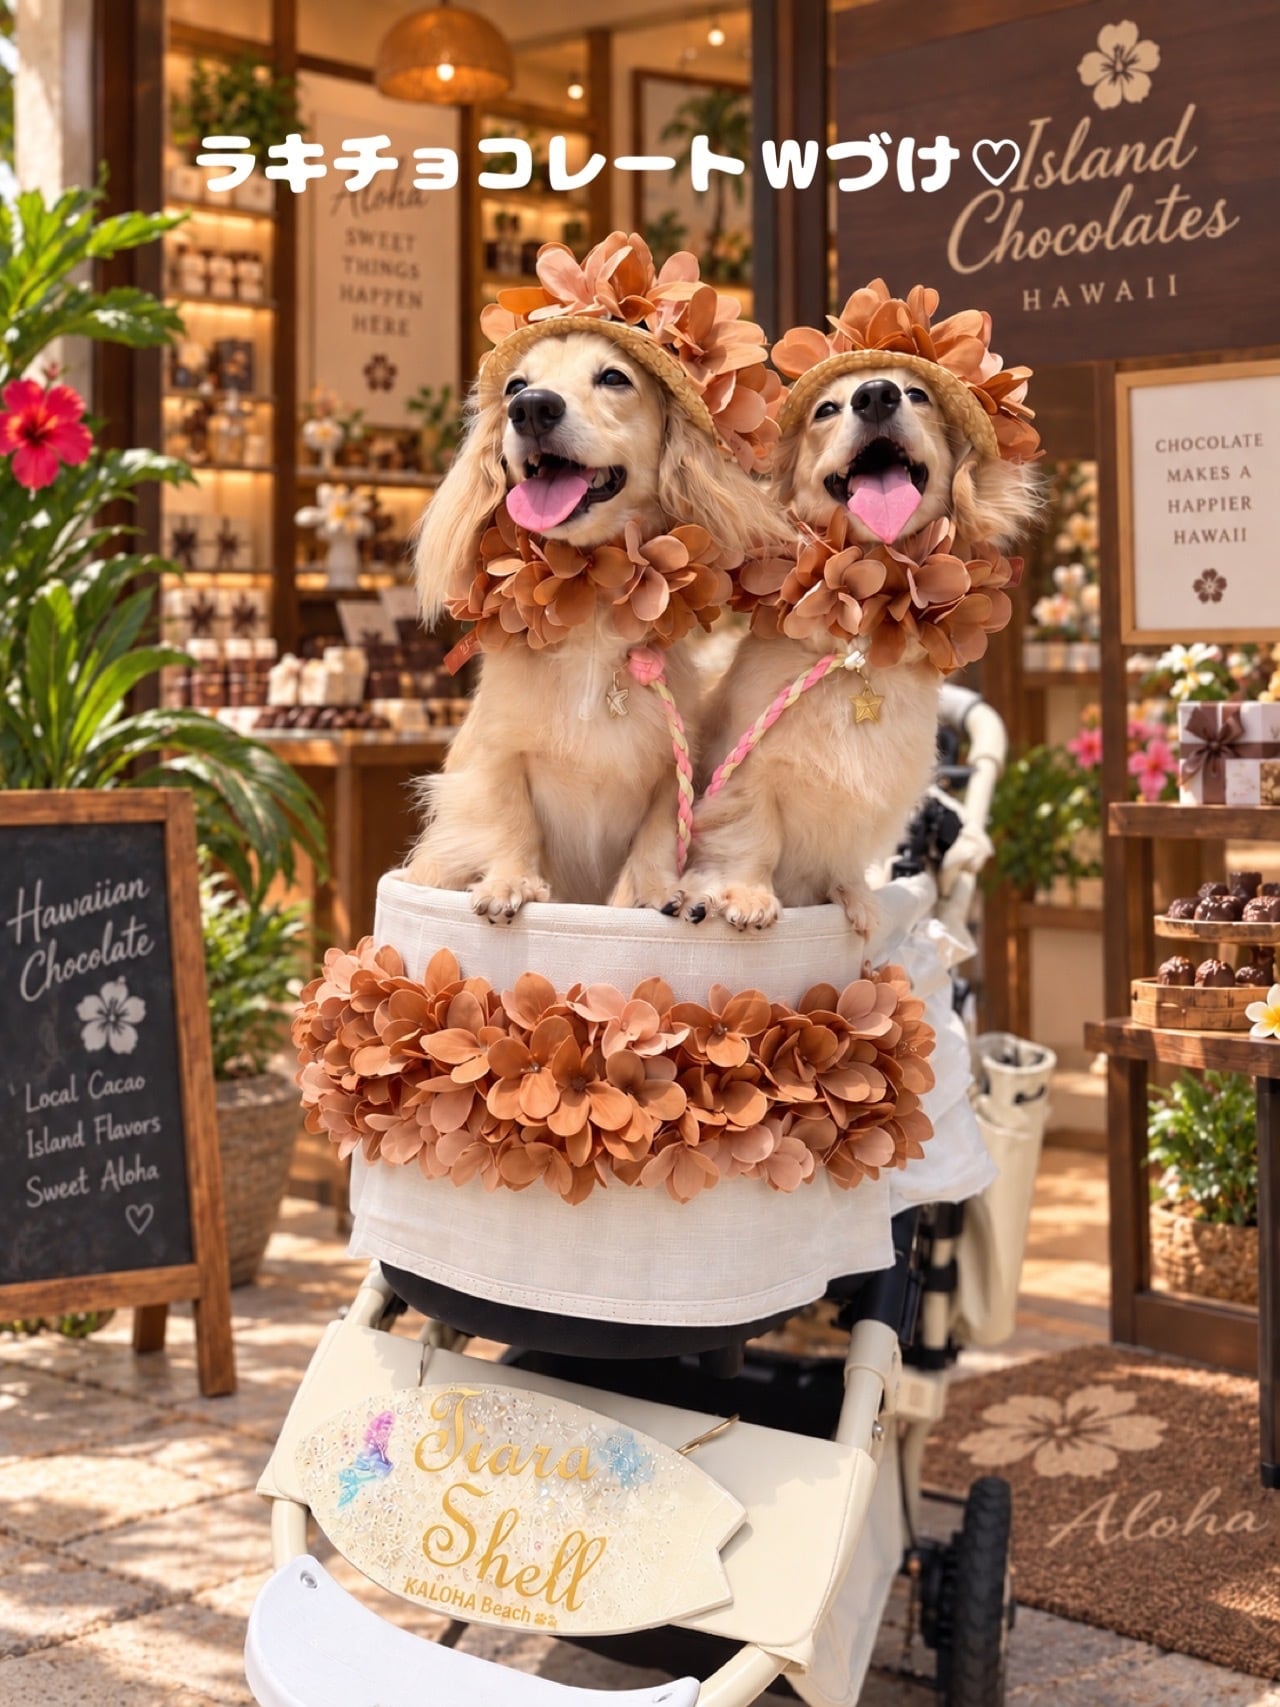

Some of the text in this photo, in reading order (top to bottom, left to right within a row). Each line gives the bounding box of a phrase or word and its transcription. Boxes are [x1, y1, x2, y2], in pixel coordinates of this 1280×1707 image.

[1009, 103, 1198, 193] Island
[344, 227, 416, 252] SWEET
[947, 183, 1240, 275] Chocolates
[342, 255, 421, 280] THINGS
[339, 283, 423, 310] HAPPEN
[1022, 274, 1178, 312] HAWAII
[352, 313, 410, 337] HERE
[1154, 433, 1265, 453] CHOCOLATE
[1167, 464, 1252, 483] MAKES A
[1167, 495, 1252, 514] HAPPIER
[1173, 527, 1248, 545] HAWAII
[6, 877, 151, 945] Hawaiian
[20, 914, 155, 1002] Chocolate
[25, 1069, 146, 1113] Local Cacao
[26, 1112, 161, 1159] Island Flavors
[26, 1153, 160, 1208] Sweet Aloha
[414, 1387, 598, 1481] Tiara
[1045, 1486, 1270, 1548] Aloha
[422, 1482, 607, 1612] Shell
[403, 1576, 531, 1624] KALOHA Beach
